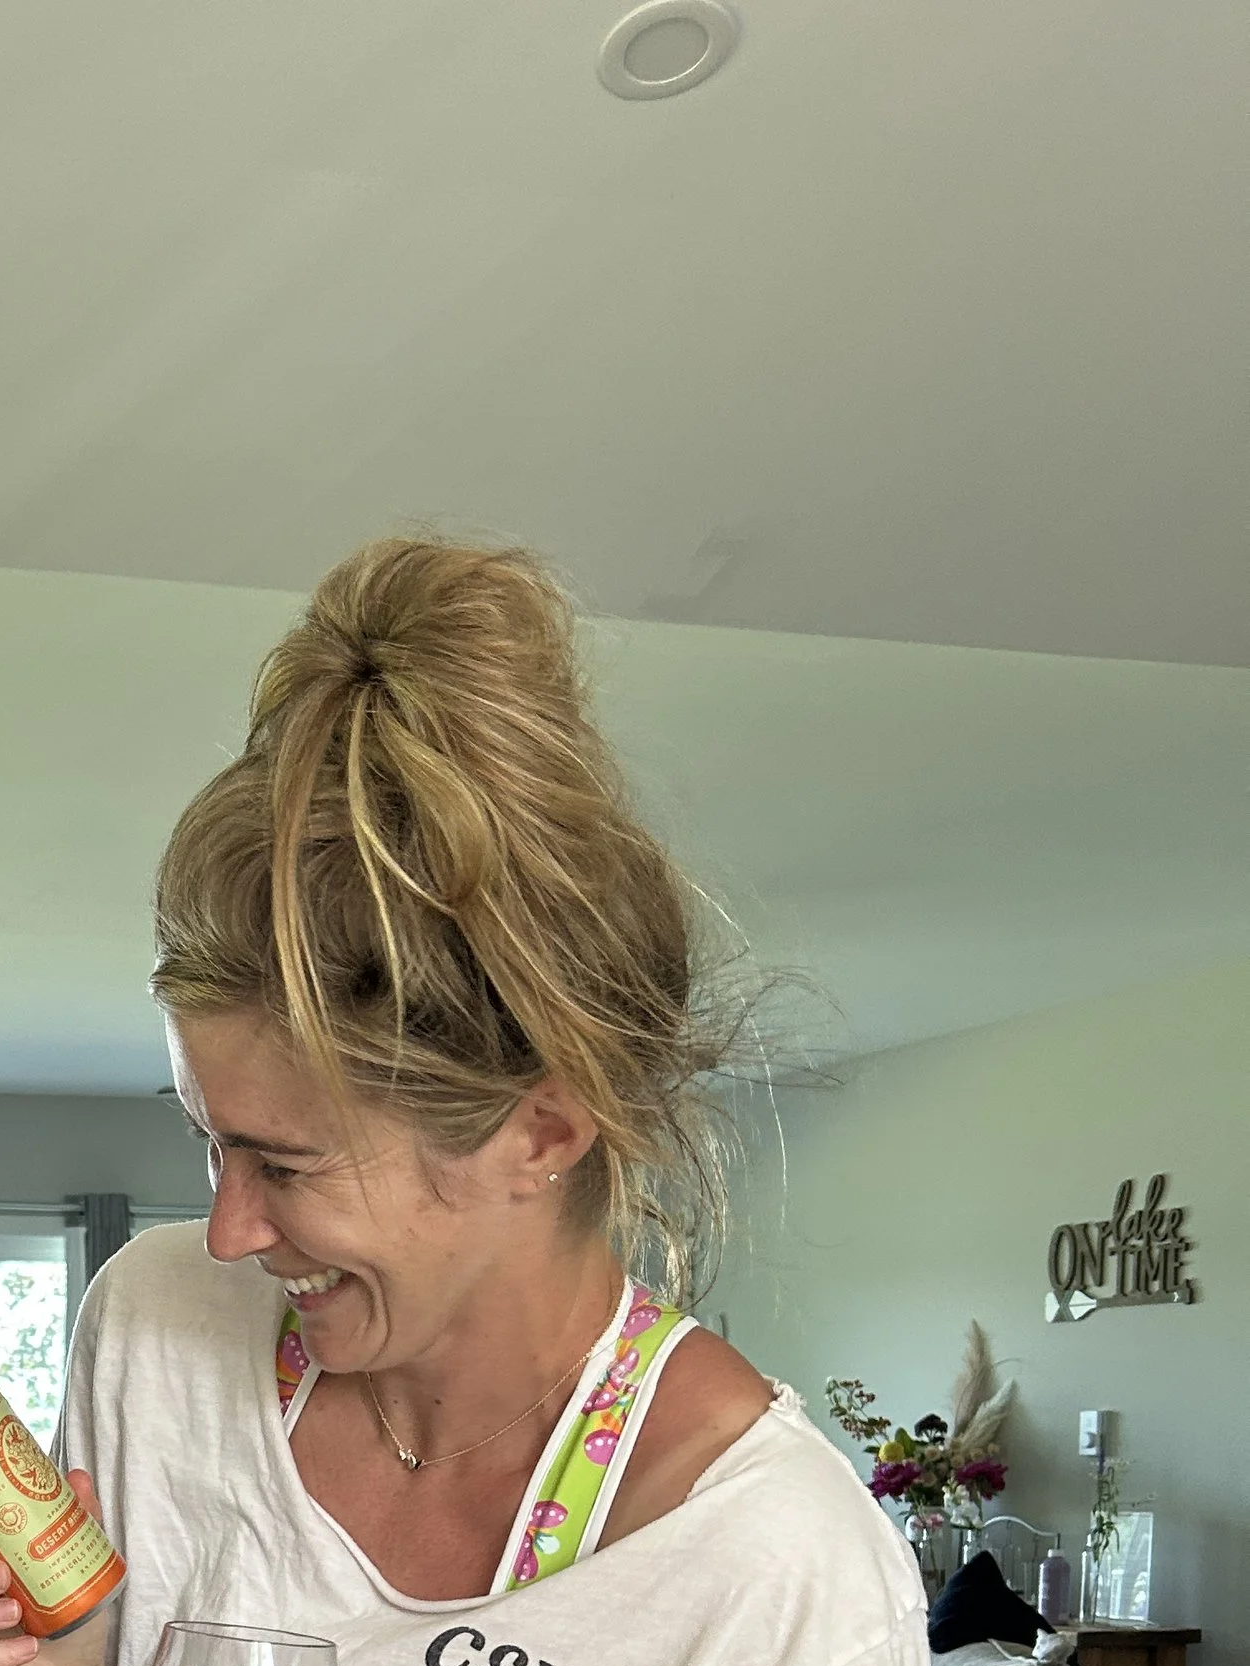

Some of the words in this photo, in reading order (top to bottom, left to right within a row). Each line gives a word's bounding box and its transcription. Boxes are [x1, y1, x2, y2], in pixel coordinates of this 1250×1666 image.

[1109, 1174, 1185, 1246] lake
[1048, 1222, 1109, 1291] ON
[1109, 1243, 1191, 1297] TIME
[35, 1520, 70, 1555] DESERT
